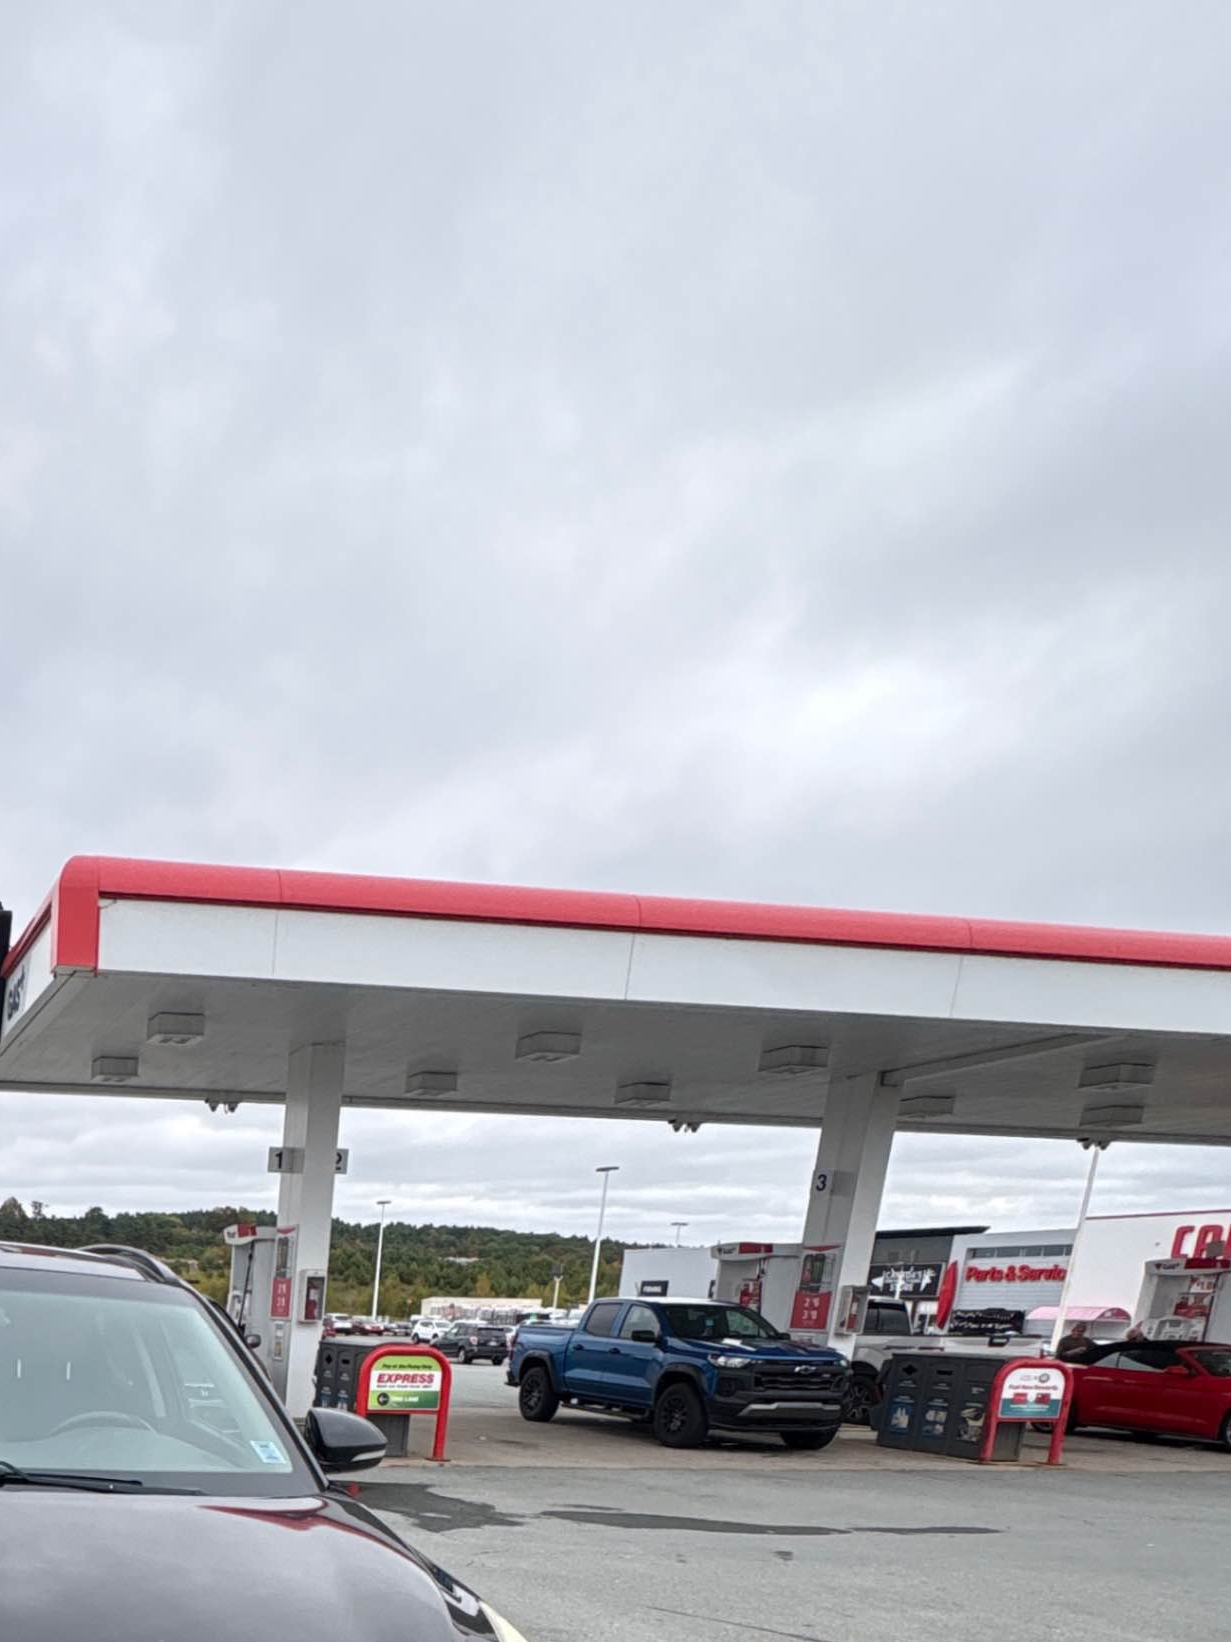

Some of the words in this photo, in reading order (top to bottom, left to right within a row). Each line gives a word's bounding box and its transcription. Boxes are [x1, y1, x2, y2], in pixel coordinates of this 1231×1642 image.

[275, 1151, 283, 1169] 1
[816, 1174, 827, 1191] 3
[1171, 1225, 1231, 1259] CA
[965, 1266, 1004, 1281] Parts
[1006, 1265, 1016, 1282] &
[1018, 1264, 1067, 1281] Servic
[376, 1373, 434, 1384] EXPRESS
